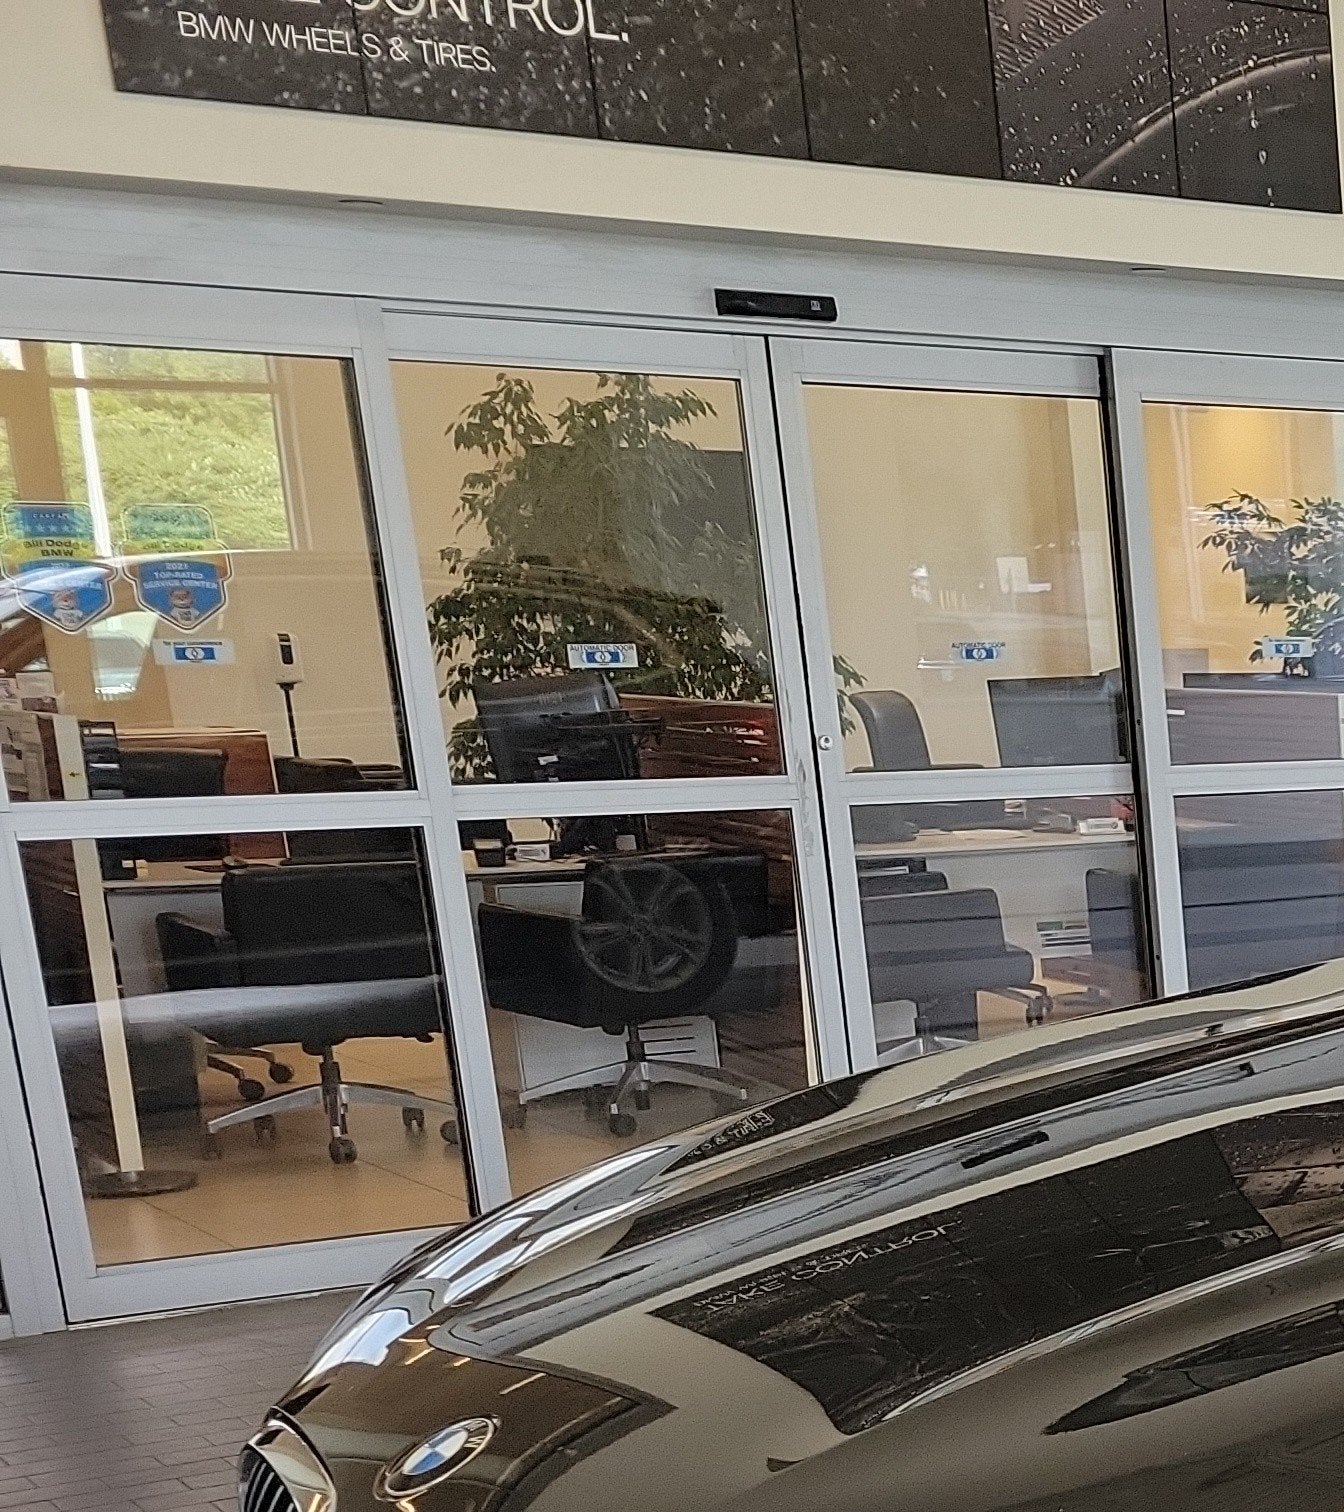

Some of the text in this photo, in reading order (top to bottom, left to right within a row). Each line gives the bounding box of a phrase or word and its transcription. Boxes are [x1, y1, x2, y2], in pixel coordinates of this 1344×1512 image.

[177, 11, 497, 73] BMW WHEELS & TIRES.
[347, 0, 629, 43] ROL.
[41, 549, 74, 557] BMW
